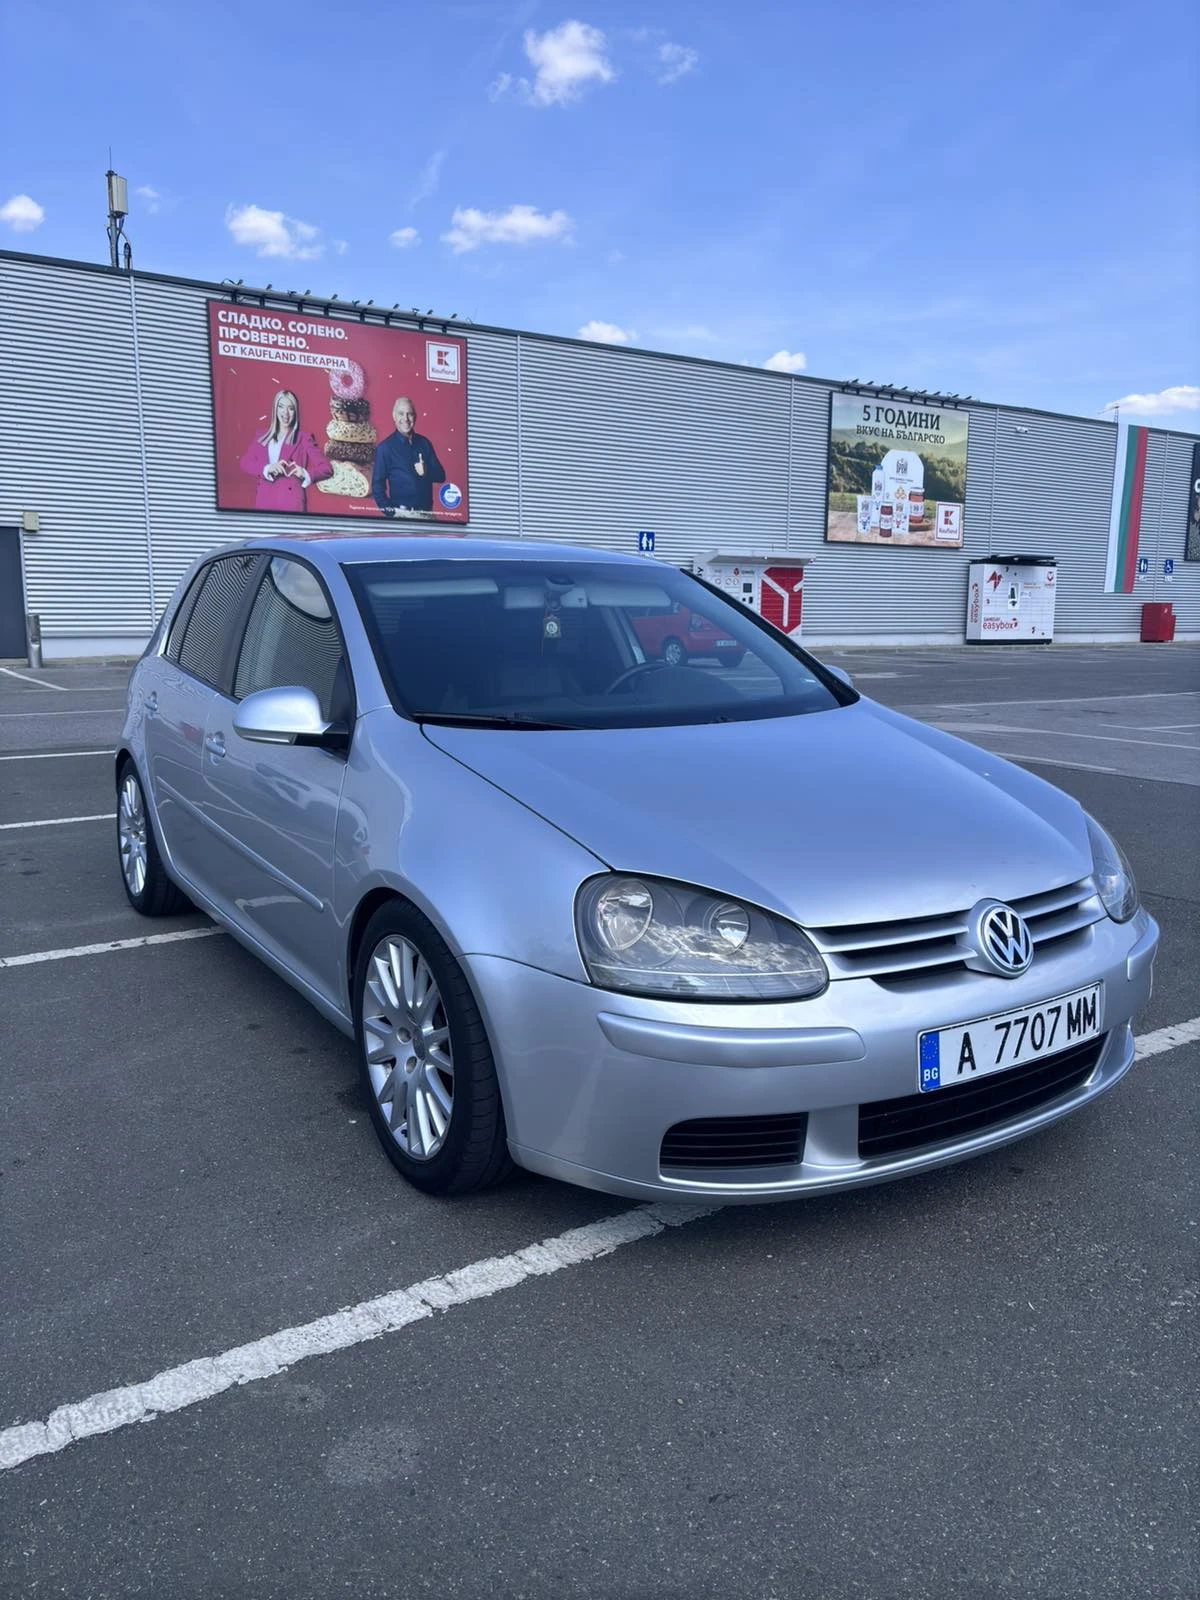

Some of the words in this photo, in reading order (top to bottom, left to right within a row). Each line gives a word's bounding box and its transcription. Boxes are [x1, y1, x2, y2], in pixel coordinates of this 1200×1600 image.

[217, 310, 285, 331] СЛАДКО.
[288, 321, 349, 340] СОЛЕНО.
[218, 326, 310, 350] ПРОВЕРЕНО.
[222, 344, 238, 354] ОТ
[240, 346, 297, 362] KAUFLAND
[299, 355, 346, 369] ПЕКАРНА
[431, 367, 456, 376] Kaufland
[862, 405, 871, 421] 5
[875, 406, 941, 431] ГОДИНИ
[856, 425, 880, 437] ВКУС
[881, 428, 894, 439] НА
[896, 431, 946, 445] БЪЛГАРСКО
[982, 620, 1014, 632] easybox
[957, 1032, 977, 1075] A
[994, 1005, 1062, 1064] 7707
[1066, 992, 1097, 1040] MM
[923, 1067, 939, 1082] BG
